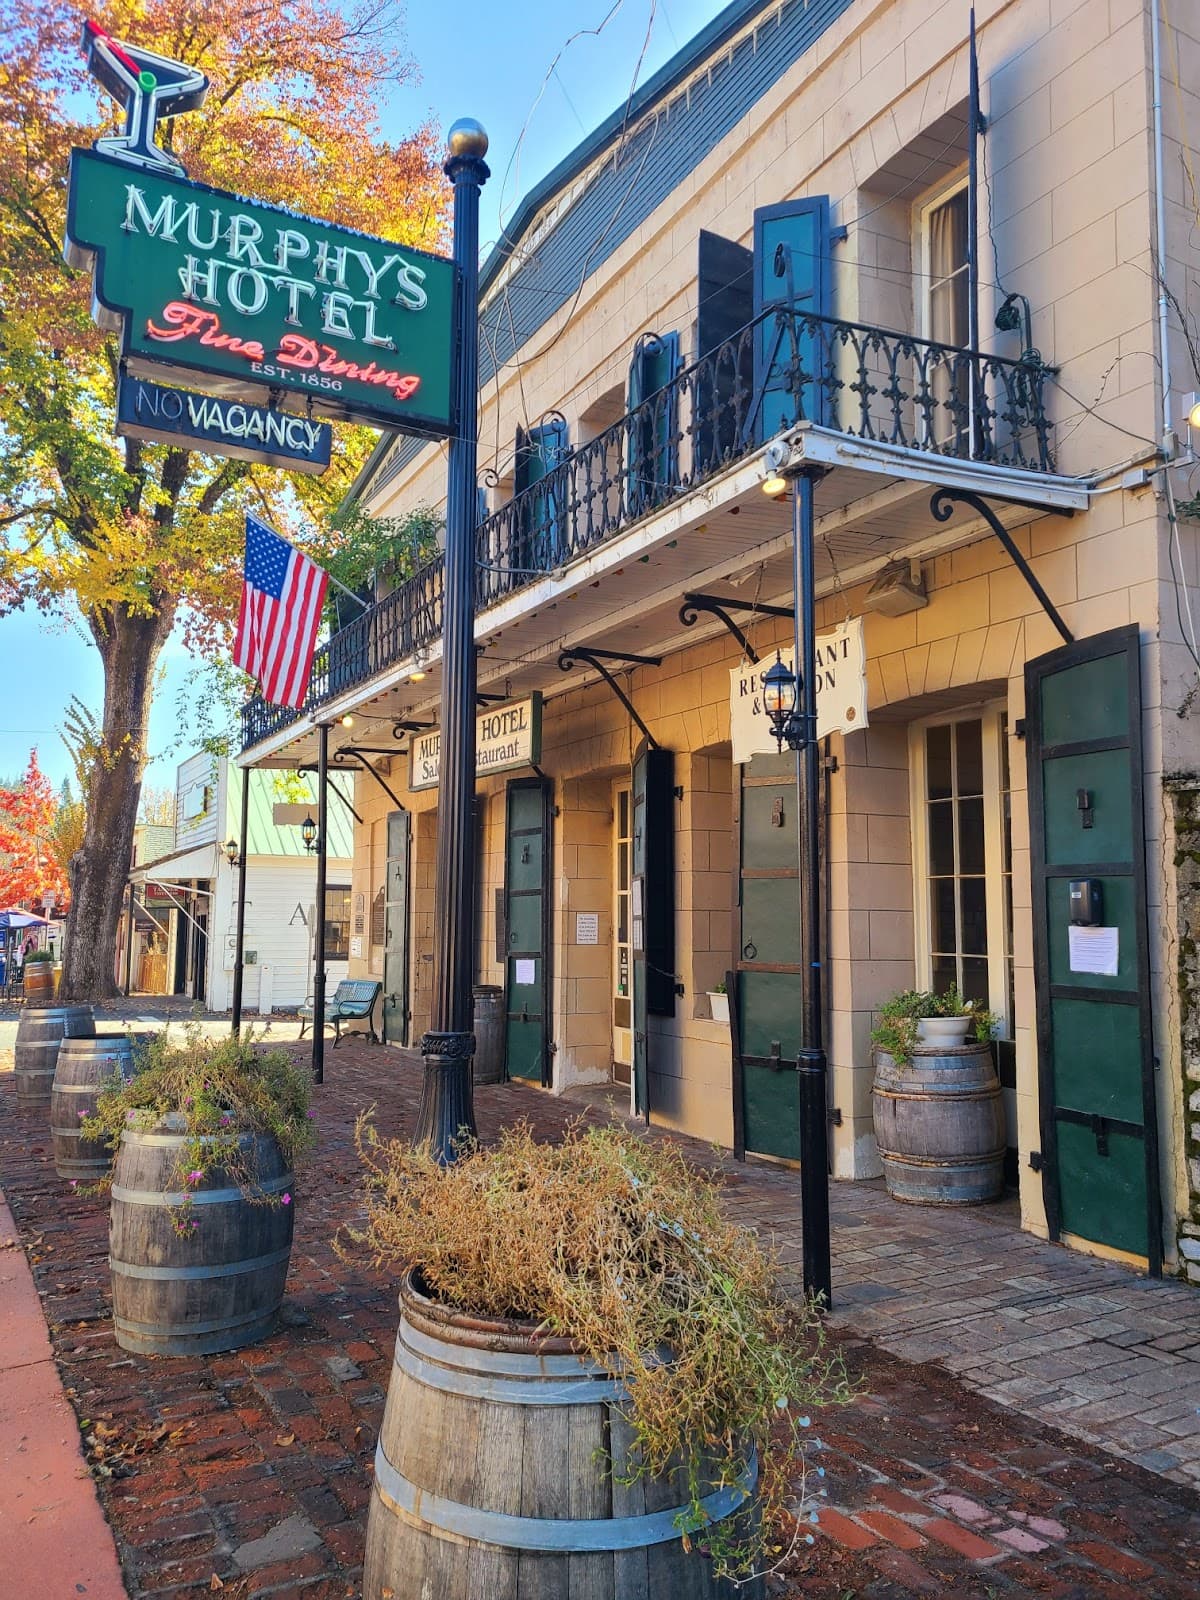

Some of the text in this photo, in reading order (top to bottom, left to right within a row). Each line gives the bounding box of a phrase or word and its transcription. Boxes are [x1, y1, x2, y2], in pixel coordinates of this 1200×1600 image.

[119, 183, 428, 311] MURPHYS
[178, 253, 398, 352] HOTEL
[146, 301, 421, 400] Fine Dining
[251, 360, 343, 391] EST. 1856
[136, 385, 322, 453] NO VACANCY
[740, 637, 851, 697] RESANT
[481, 707, 528, 741] HOTEL
[752, 696, 762, 716] &
